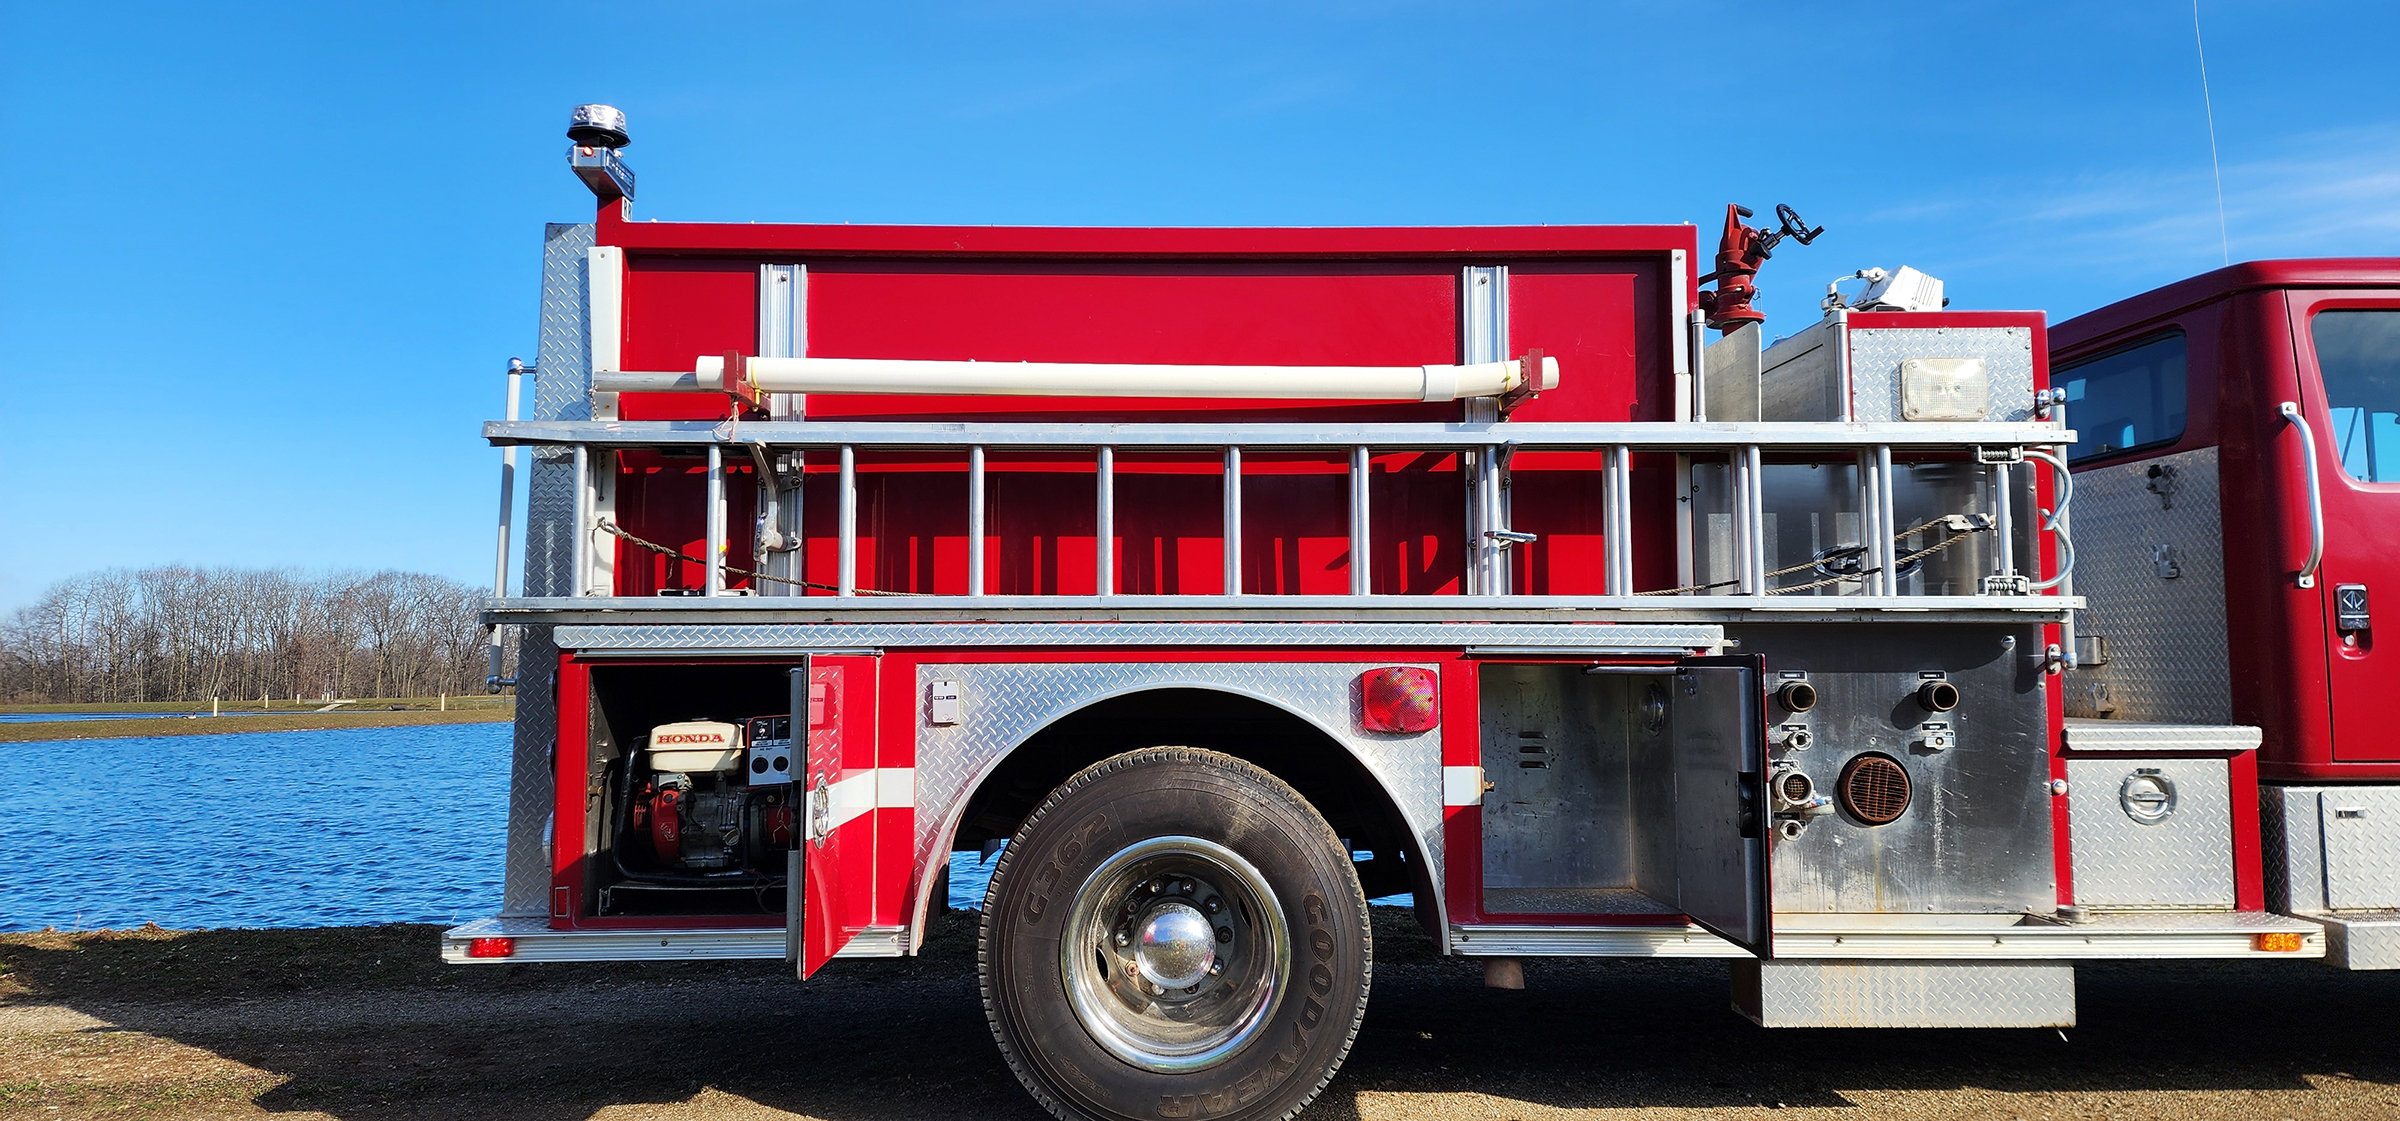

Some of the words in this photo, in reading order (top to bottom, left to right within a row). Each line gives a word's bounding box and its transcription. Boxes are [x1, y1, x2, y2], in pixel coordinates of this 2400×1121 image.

[623, 199, 632, 221] RR
[656, 733, 725, 745] HONDA
[1023, 813, 1111, 926] G362
[1156, 894, 1335, 1118] GOODYEAR
